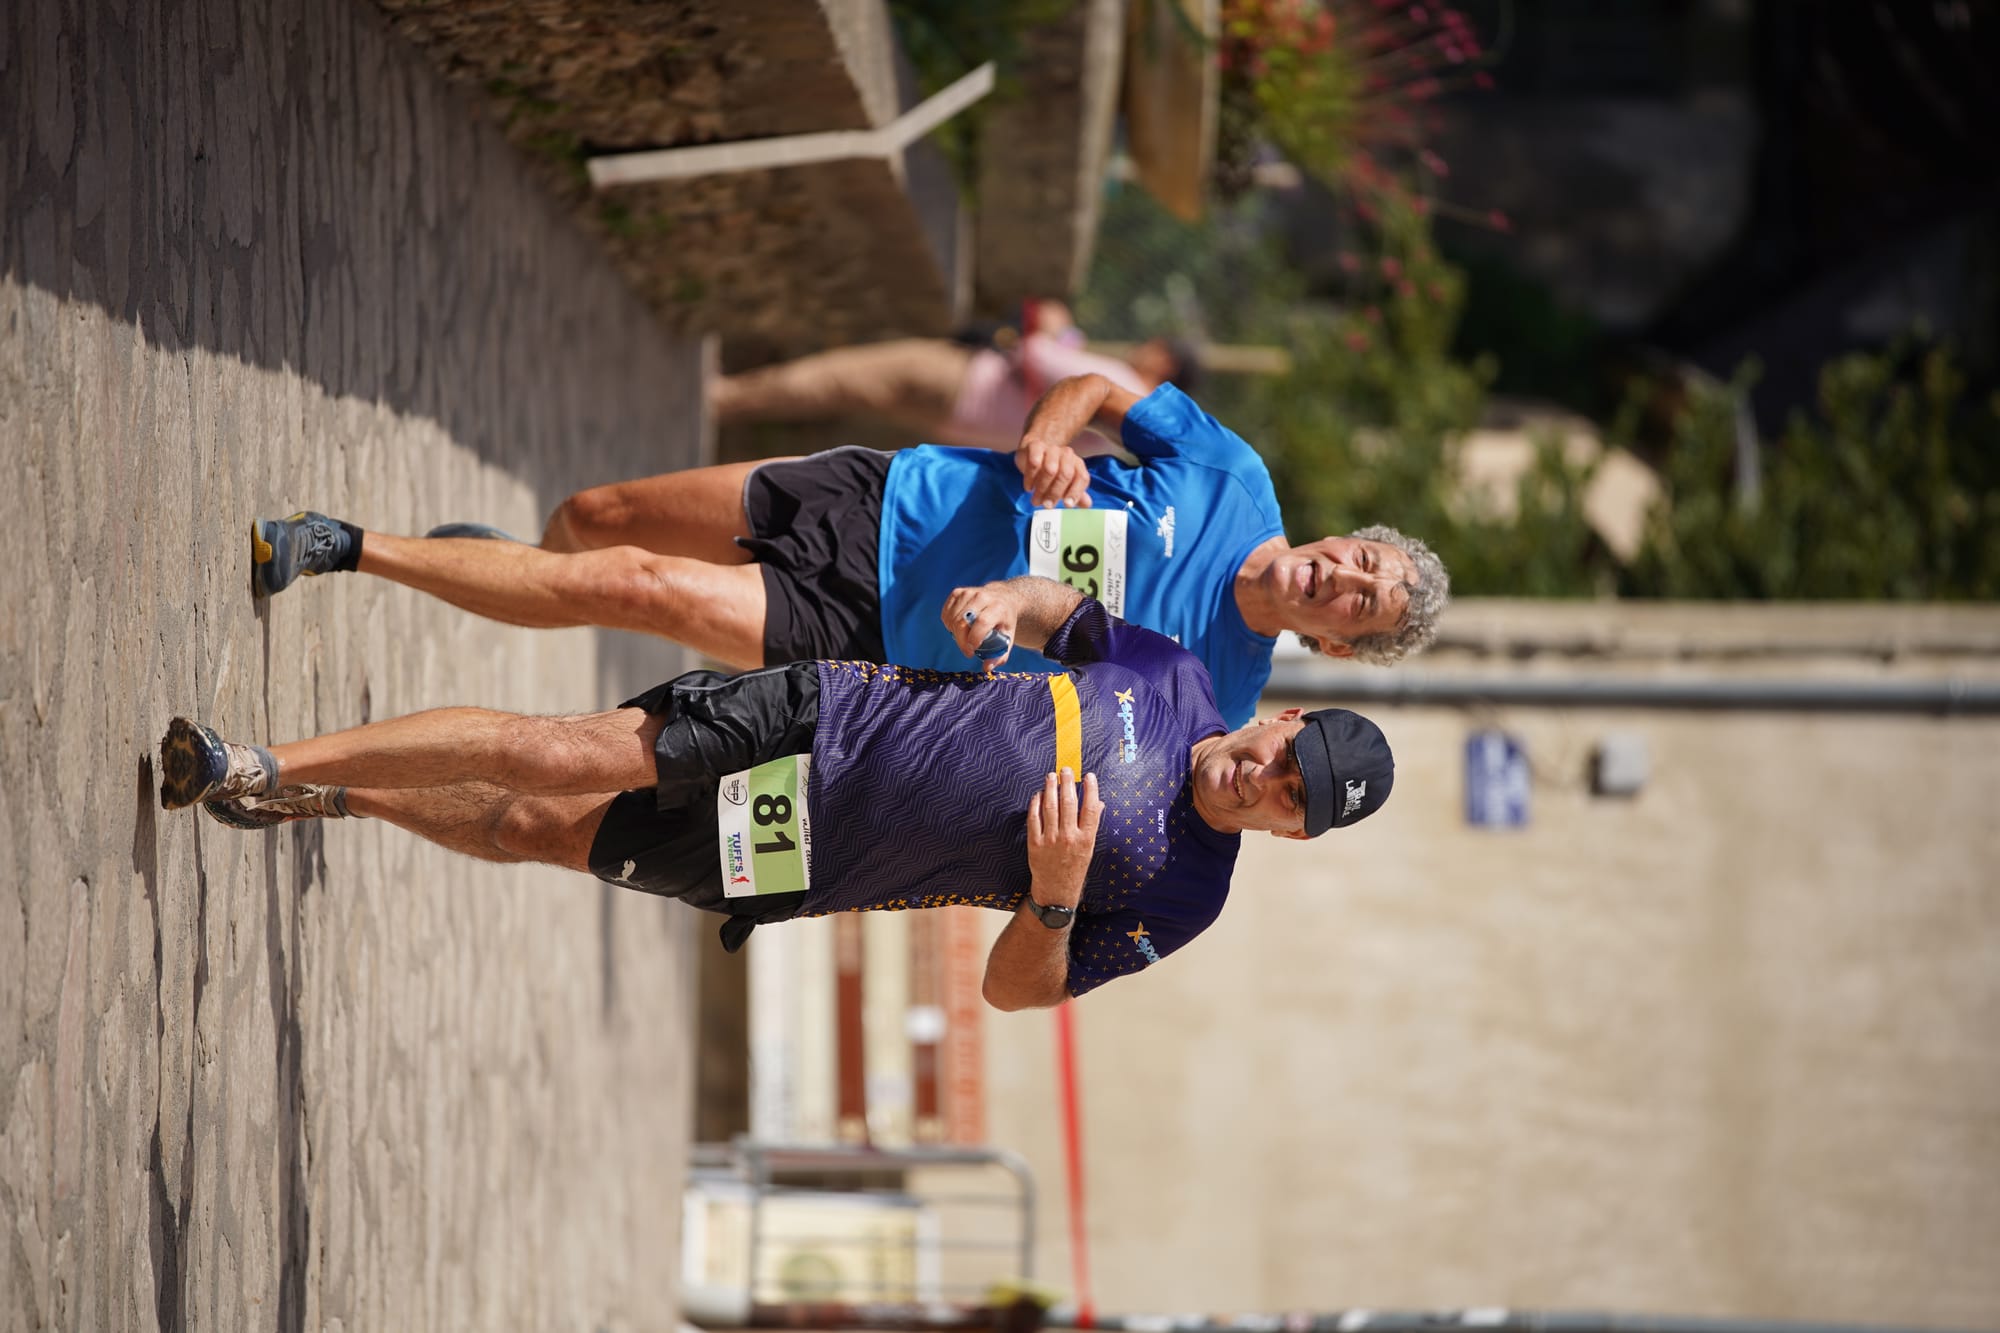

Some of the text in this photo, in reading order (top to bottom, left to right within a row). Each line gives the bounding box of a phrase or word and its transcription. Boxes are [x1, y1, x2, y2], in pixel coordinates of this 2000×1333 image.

[752, 794, 796, 855] 81
[1157, 808, 1165, 835] TACTIC
[726, 835, 736, 878] Aventure
[732, 832, 744, 873] TUFF'S
